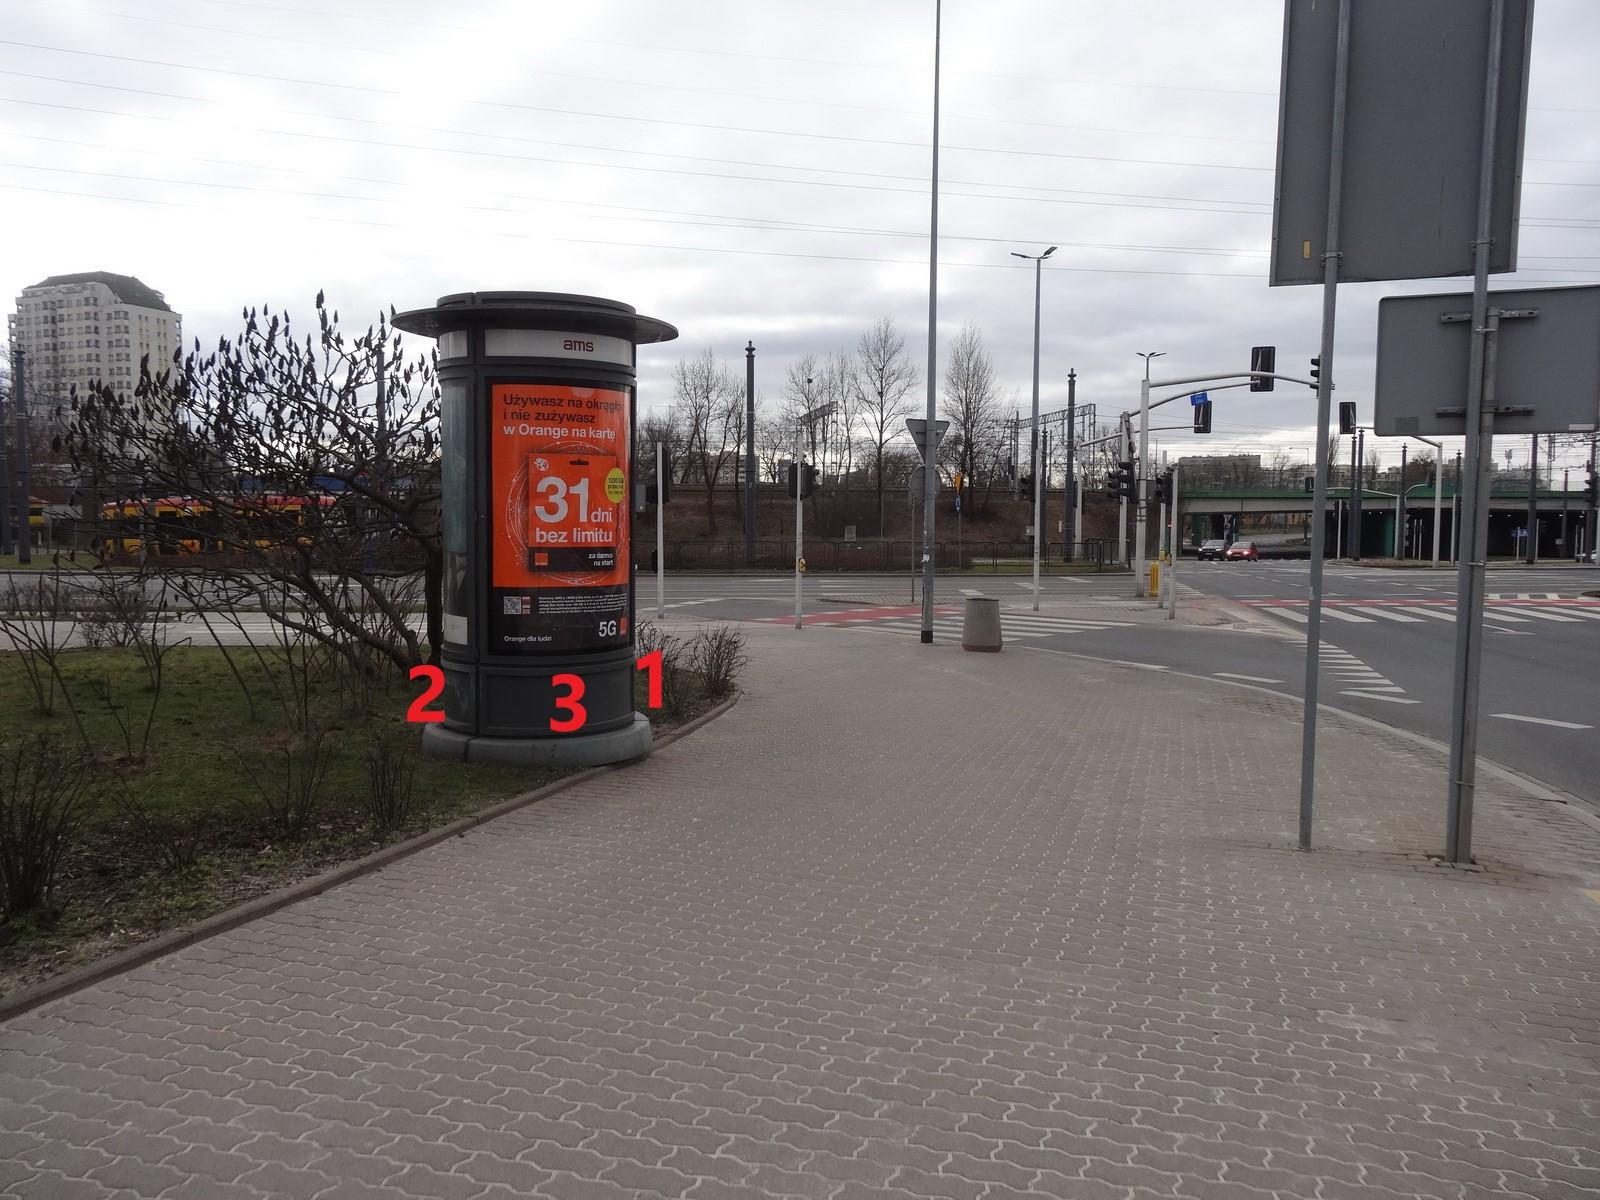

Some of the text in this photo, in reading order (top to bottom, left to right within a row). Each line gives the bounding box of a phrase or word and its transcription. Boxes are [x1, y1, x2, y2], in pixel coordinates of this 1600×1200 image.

[563, 339, 594, 352] ams
[503, 393, 564, 408] Używasz
[567, 399, 583, 408] na
[503, 409, 596, 424] i nie zużywasz
[503, 423, 616, 441] w Orange na kartę
[534, 476, 613, 523] 31 dni
[535, 527, 613, 543] bez limitu
[598, 620, 617, 637] 5G
[504, 635, 526, 643] Orange
